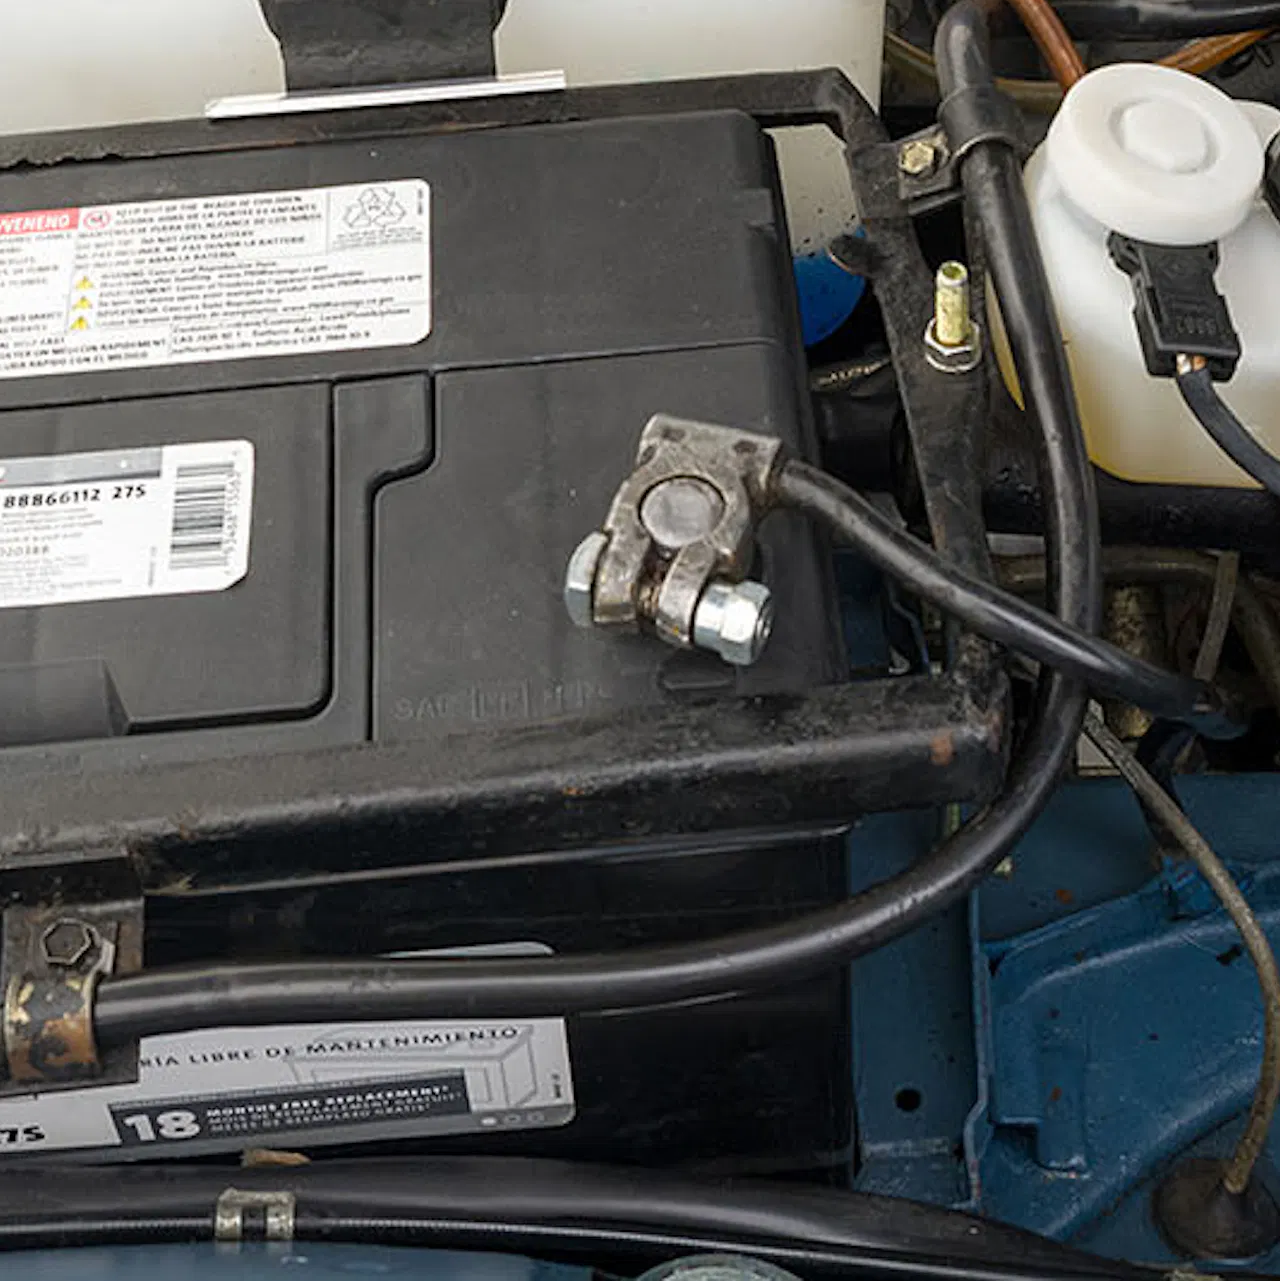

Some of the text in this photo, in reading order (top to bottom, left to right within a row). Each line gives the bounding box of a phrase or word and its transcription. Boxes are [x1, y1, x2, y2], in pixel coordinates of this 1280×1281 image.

[3, 488, 102, 509] 88866112
[189, 1048, 257, 1064] LIBRE
[265, 1046, 296, 1058] DE
[306, 1027, 518, 1054] MANTENIMIENTO
[122, 1109, 202, 1142] 18
